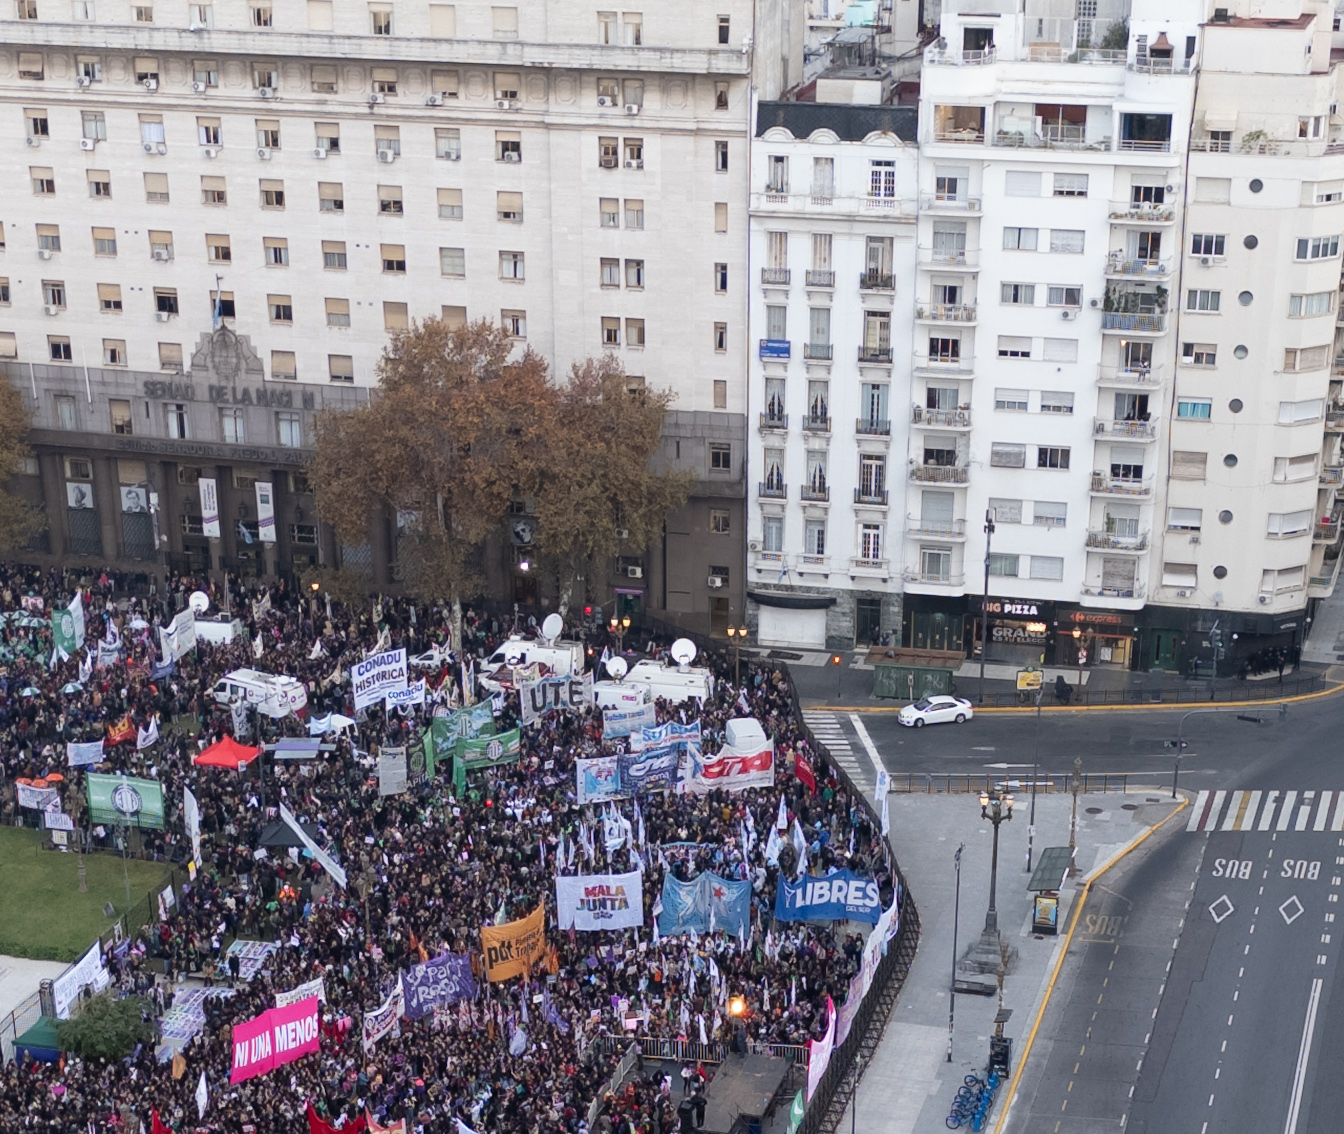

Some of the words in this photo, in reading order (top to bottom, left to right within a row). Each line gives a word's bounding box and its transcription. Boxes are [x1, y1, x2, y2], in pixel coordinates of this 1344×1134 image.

[1004, 604, 1038, 616] PIZZA
[1086, 615, 1122, 624] express
[358, 652, 402, 676] CONADU
[388, 683, 423, 699] conadu
[530, 680, 584, 712] UTE
[1212, 858, 1253, 880] BUS
[1281, 859, 1321, 880] BUS
[584, 885, 626, 897] MALA
[795, 879, 880, 909] LIBRES
[575, 897, 630, 911] JUNTA
[235, 1042, 249, 1069] NI
[251, 1030, 272, 1063] UNA
[274, 1012, 319, 1053] MENOS
